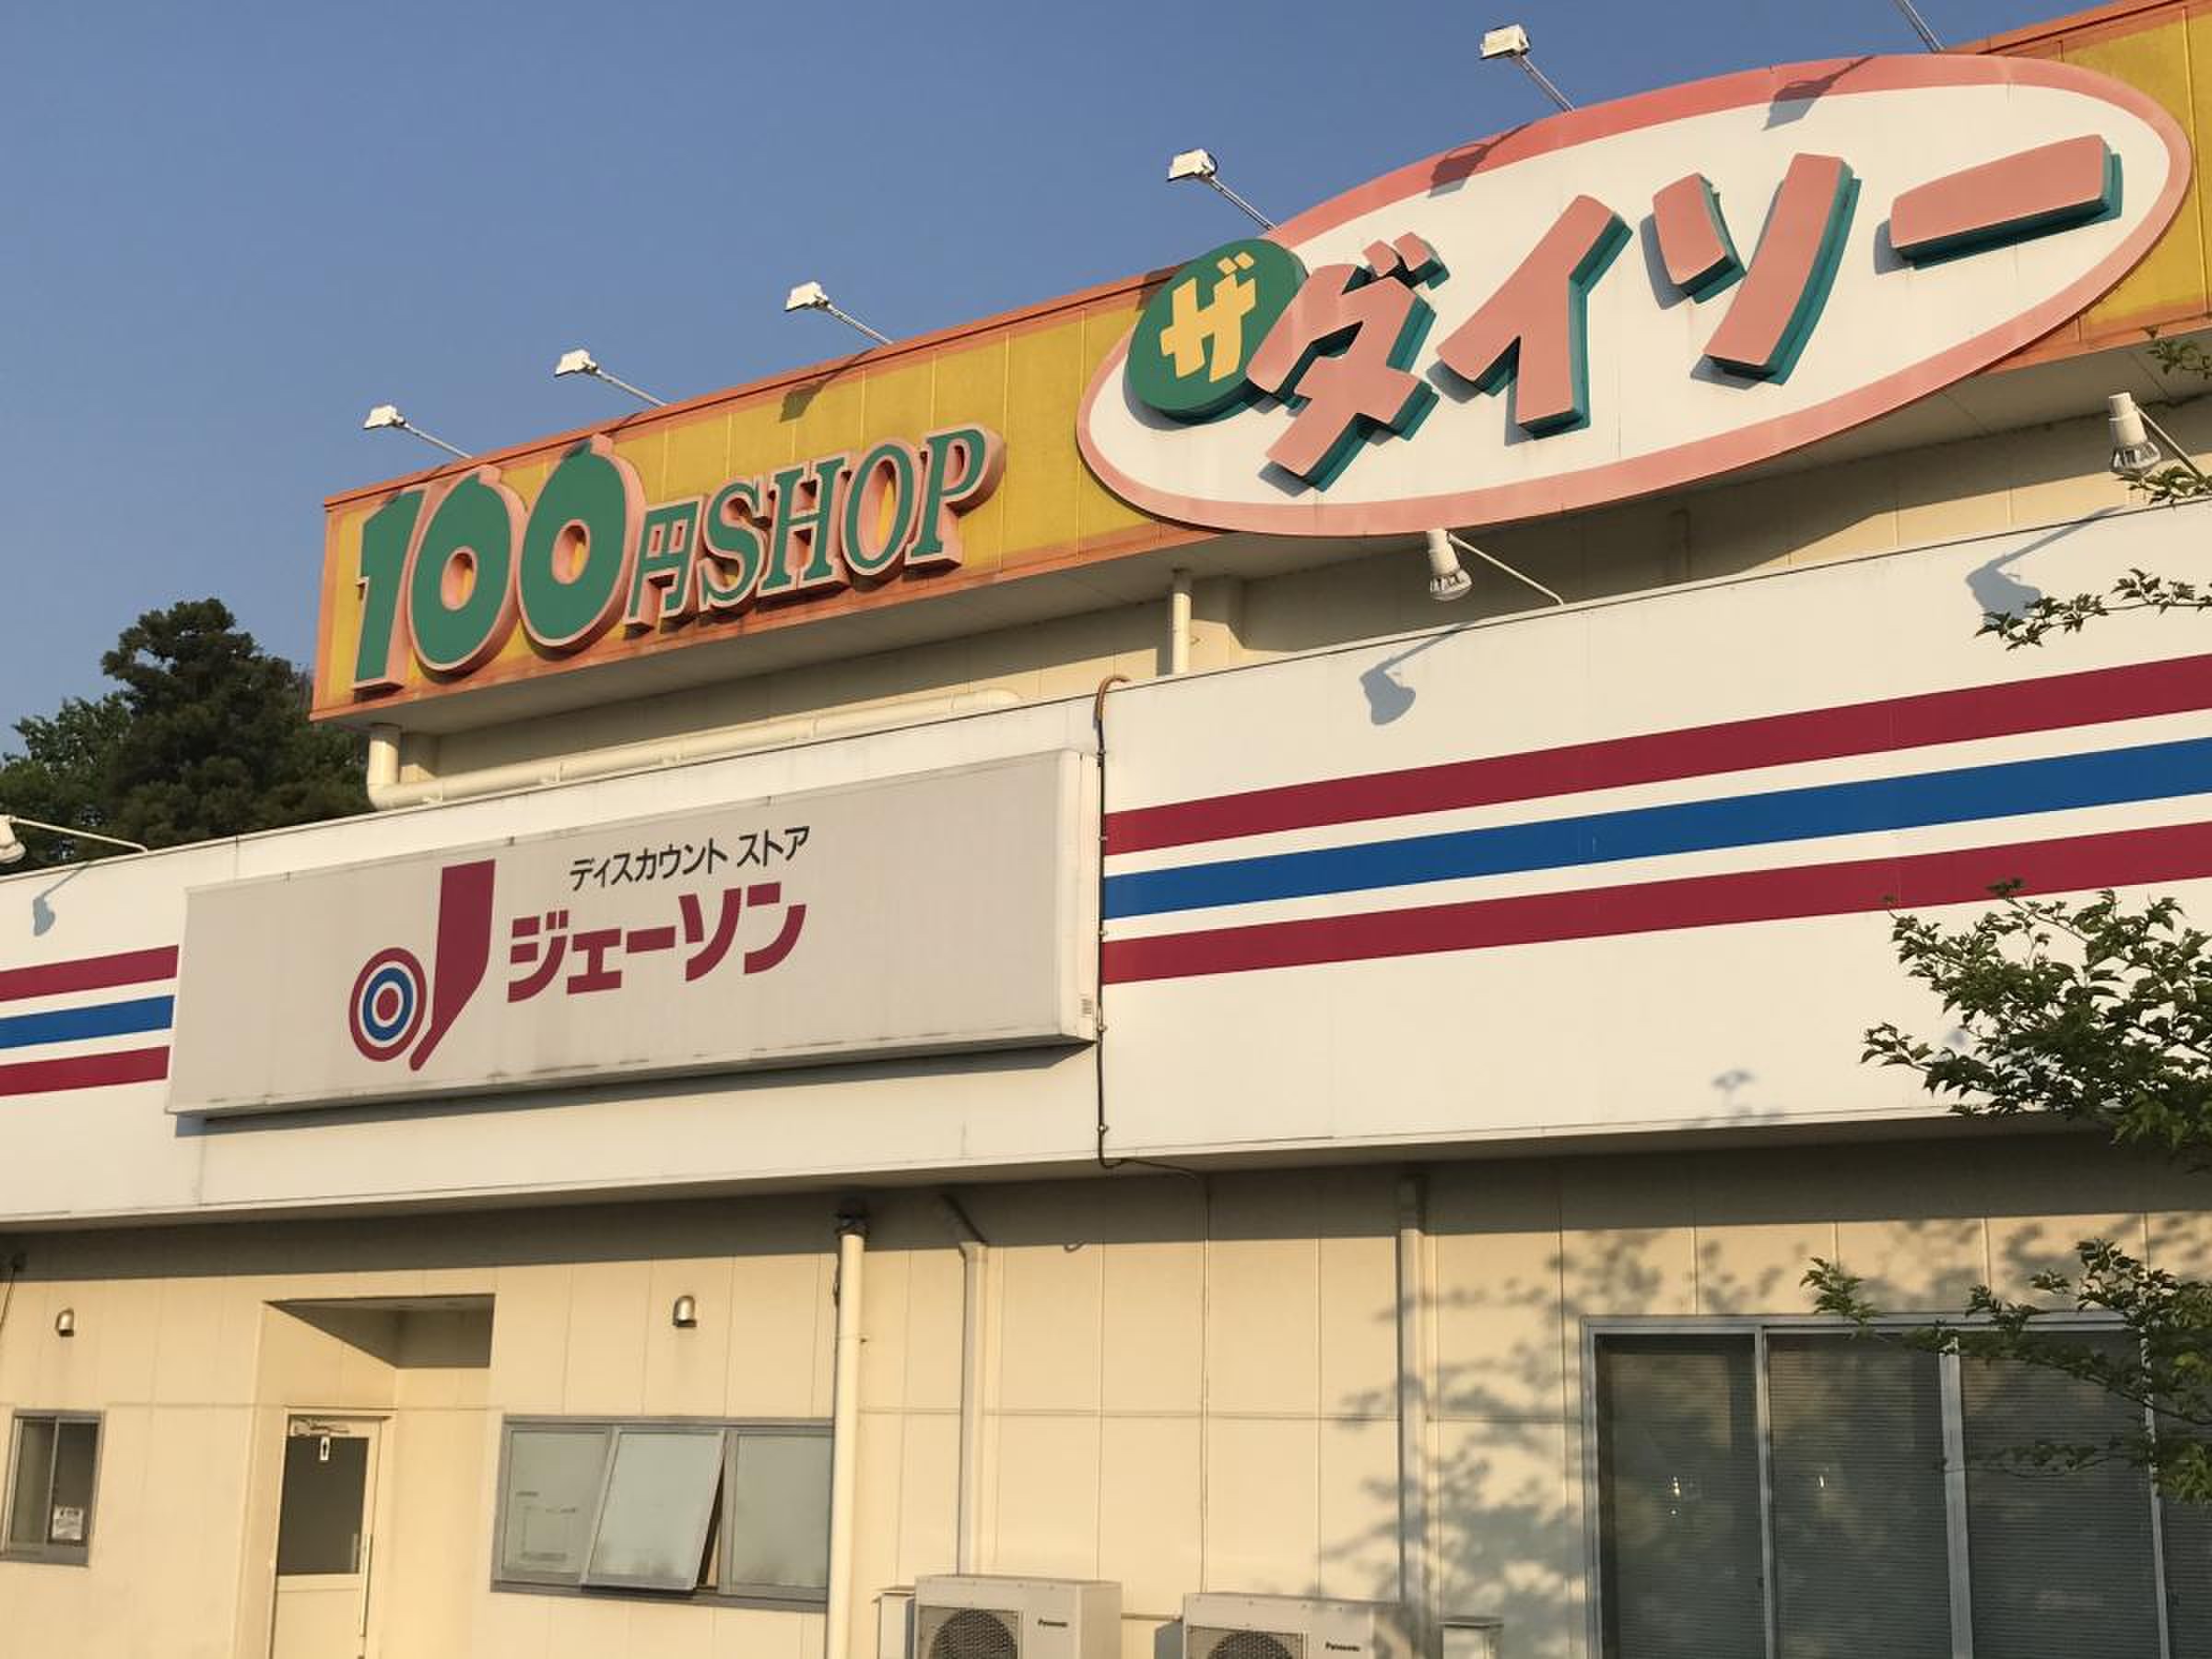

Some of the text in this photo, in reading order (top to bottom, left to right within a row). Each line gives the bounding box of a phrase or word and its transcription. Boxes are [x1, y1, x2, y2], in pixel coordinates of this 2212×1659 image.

[1158, 135, 2124, 490] ザ ダイソー
[569, 826, 811, 891] ディスカウント ストア
[507, 881, 808, 1004] ジェーソン
